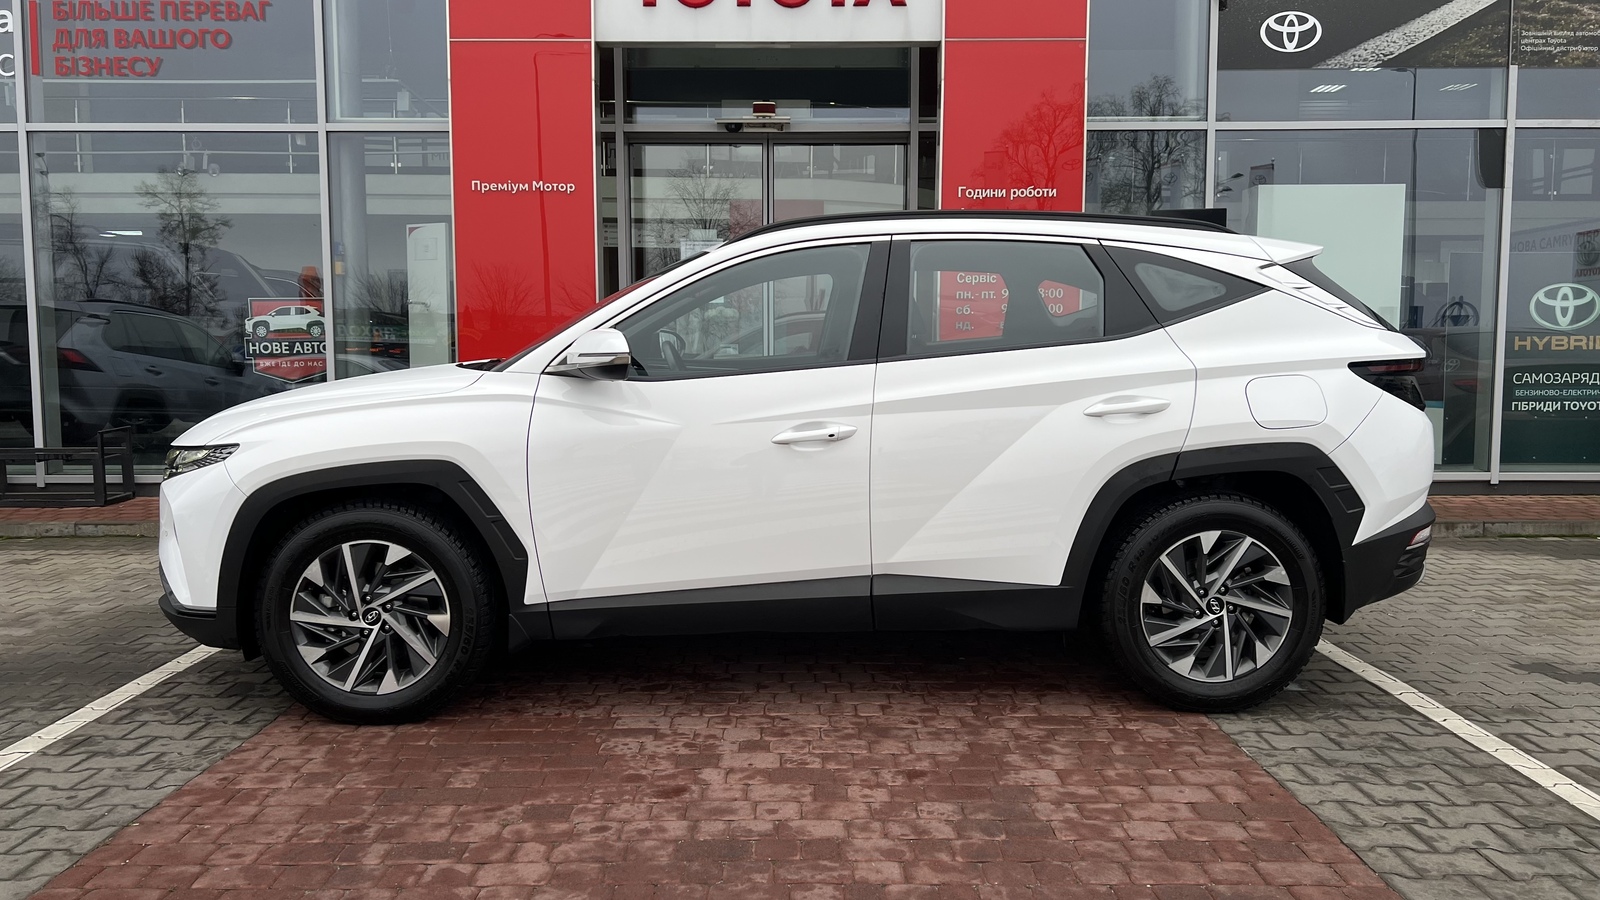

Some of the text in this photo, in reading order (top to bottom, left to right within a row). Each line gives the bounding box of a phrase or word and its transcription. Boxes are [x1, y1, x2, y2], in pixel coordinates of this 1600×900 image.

[52, 0, 271, 21] БІЛЬШЕ ПЕРЕВАГ
[52, 28, 232, 51] ДЛЯ ВАШОГО
[54, 56, 162, 76] БІЗНЕСУ
[471, 180, 576, 194] Преміум Мотор
[958, 185, 1057, 200] Години роботи
[956, 272, 997, 285] Сервіс
[981, 290, 996, 299] пт.
[956, 305, 974, 315] сб.
[955, 322, 975, 331] нд.
[249, 341, 290, 354] НОВЕ
[1514, 335, 1600, 351] HYBRI
[1512, 401, 1561, 412] ГІБРИДИ
